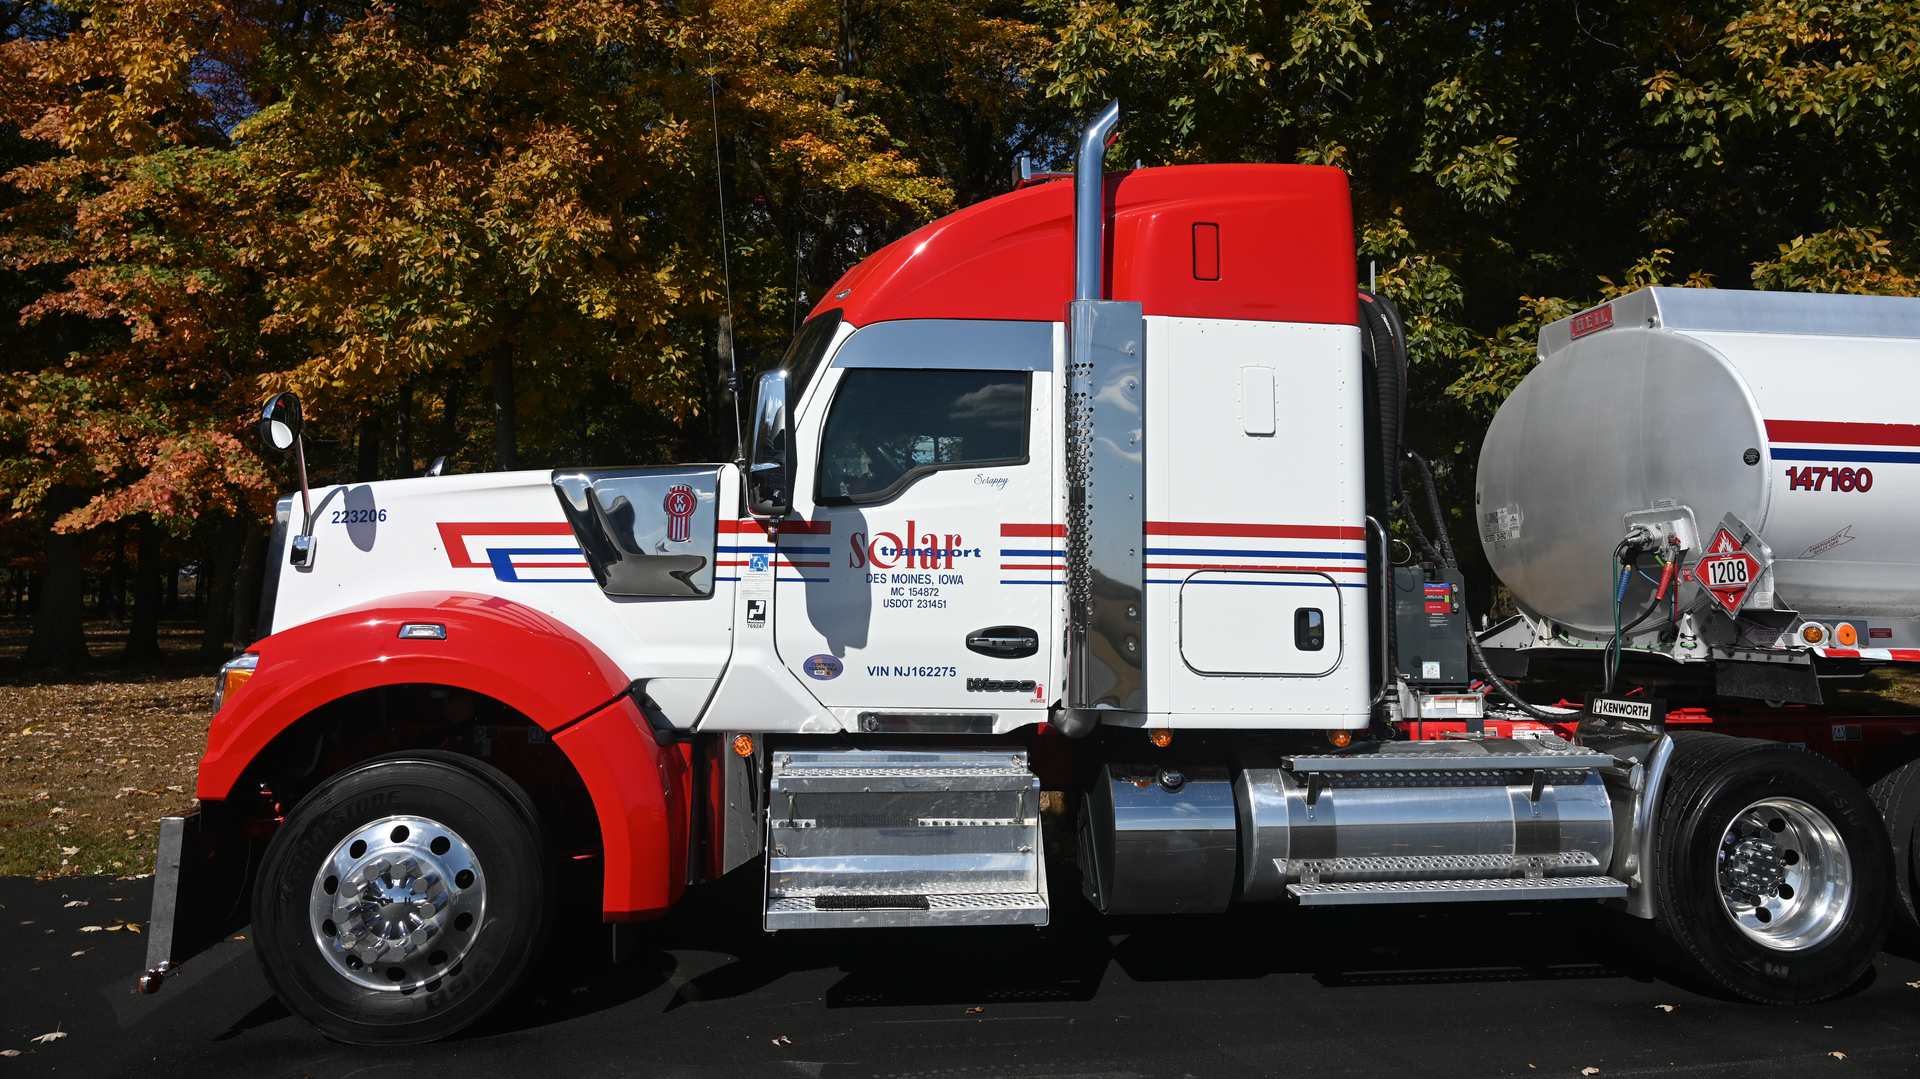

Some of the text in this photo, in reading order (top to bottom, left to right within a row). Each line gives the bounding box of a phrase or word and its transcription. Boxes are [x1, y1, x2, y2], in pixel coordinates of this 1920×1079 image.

[1576, 310, 1608, 333] HEIL
[973, 473, 1009, 491] Scrappy
[1785, 466, 1874, 493] 147160
[331, 508, 387, 524] 223206
[849, 519, 962, 570] solar
[1809, 533, 1842, 553] EMERGENCY
[1813, 540, 1839, 554] SHUT OFF
[880, 546, 982, 560] transport
[865, 573, 964, 586] DES MOINES, IOWA
[1709, 560, 1747, 584] 1208
[890, 587, 939, 597] MC 154872
[1727, 592, 1735, 603] 3
[883, 599, 947, 608] USDOT 231451
[867, 666, 957, 677] VIN NJ162275
[1603, 701, 1649, 717] KENWORTH
